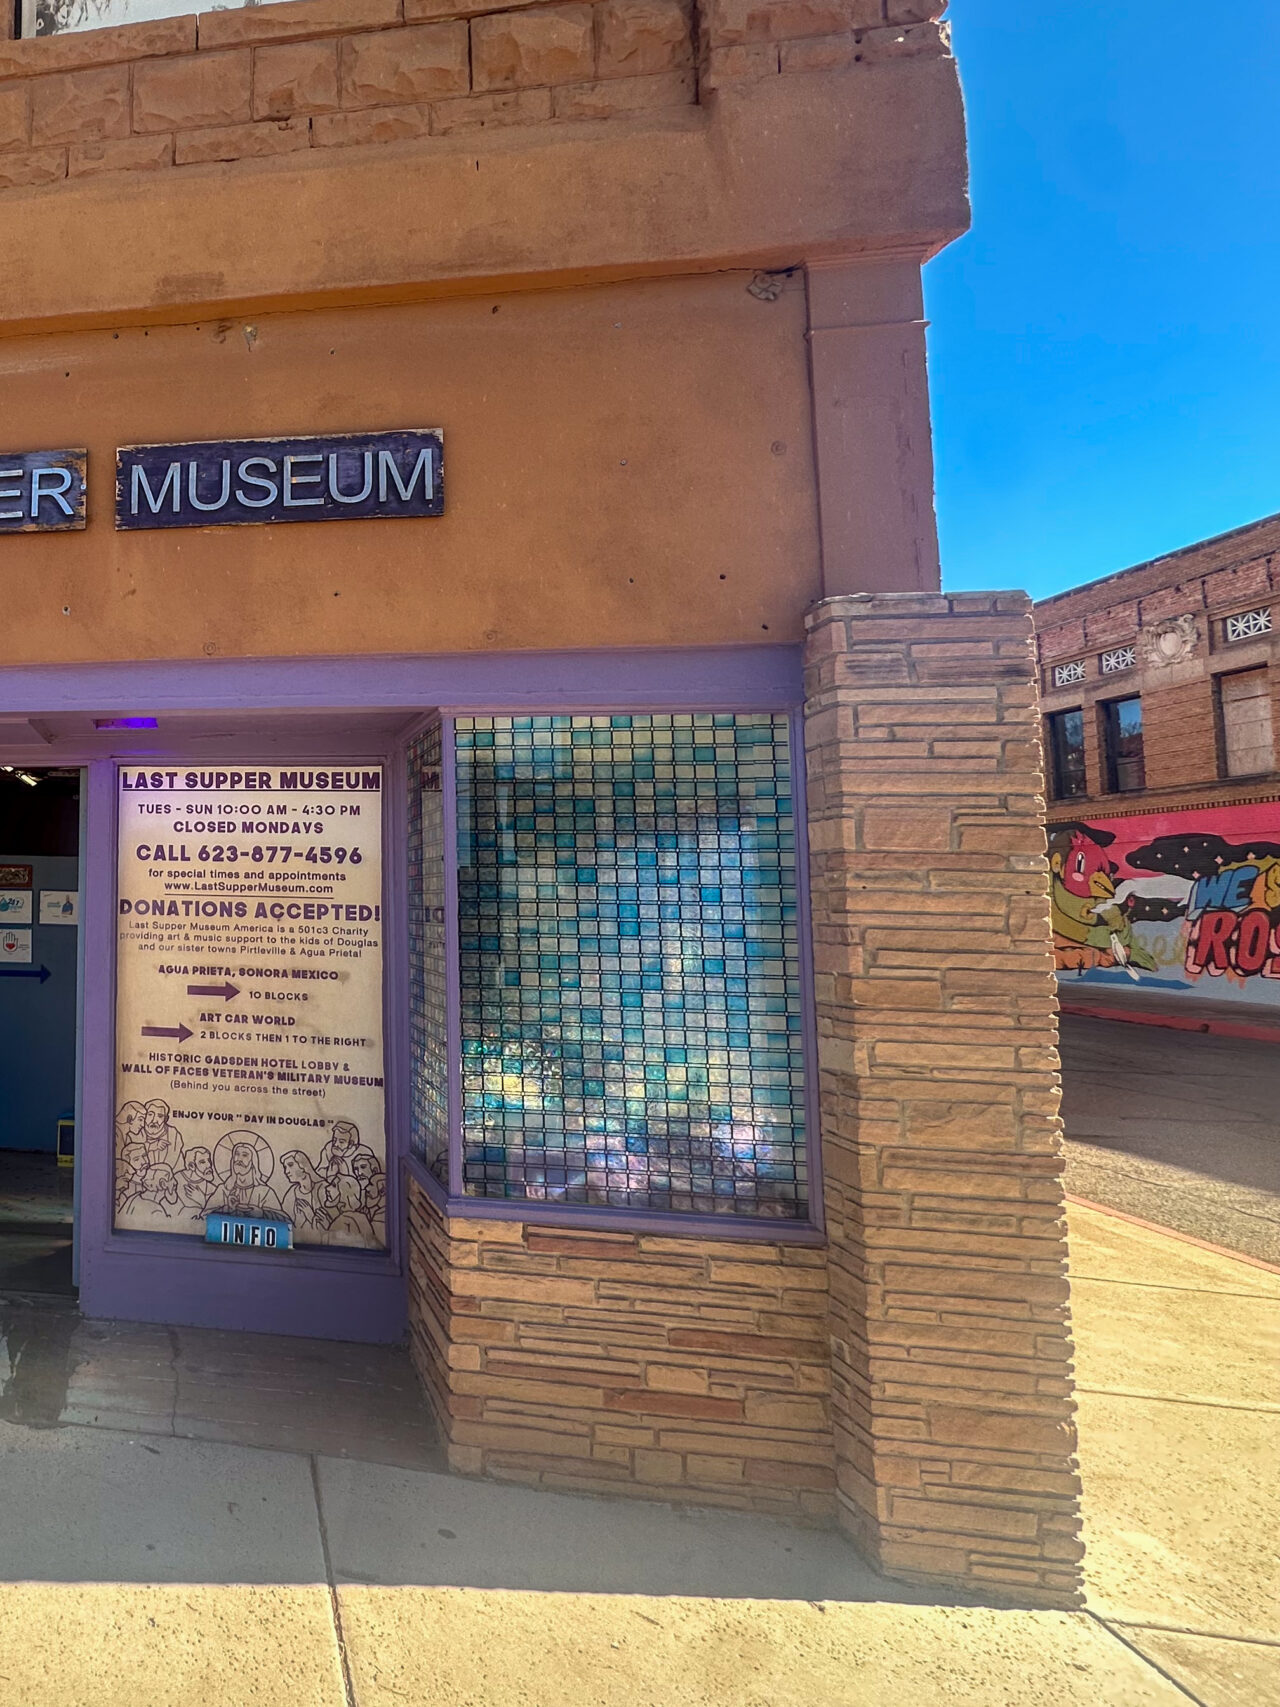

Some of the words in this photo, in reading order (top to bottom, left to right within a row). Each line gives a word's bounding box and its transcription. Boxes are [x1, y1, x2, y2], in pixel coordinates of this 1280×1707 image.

[129, 447, 435, 515] MUSEUM
[122, 771, 178, 789] LAST
[184, 771, 272, 789] SUPPER
[279, 771, 381, 790] MUSEUM
[137, 803, 172, 815] TUES
[185, 803, 213, 815] SUN
[217, 804, 262, 815] 10:00
[266, 804, 288, 815] AM
[302, 804, 336, 816] 4:30
[340, 804, 361, 816] PM
[173, 821, 237, 833] CLOSED
[241, 821, 324, 834] MONDAYS
[136, 844, 191, 861] CALL
[197, 844, 363, 864] 623-877-4596
[148, 868, 164, 878] for
[166, 868, 207, 880] special
[209, 869, 240, 879] times
[243, 869, 265, 880] and
[268, 870, 347, 882] appointments
[164, 881, 334, 894] www.LastSupperMuseum.com
[1194, 864, 1260, 910] WE
[119, 899, 248, 918] DONATIONS
[254, 901, 381, 922] ACCEPTED!
[129, 920, 149, 930] Last
[152, 921, 187, 932] Supper
[190, 922, 230, 932] Museum
[233, 923, 274, 933] America
[277, 924, 286, 933] is
[298, 925, 329, 935] 501c3
[331, 926, 370, 938] Charity
[120, 932, 164, 942] providing
[167, 932, 181, 941] art
[183, 933, 191, 942] &
[193, 933, 223, 943] music
[225, 934, 263, 945] support
[266, 935, 278, 944] to
[280, 935, 296, 945] the
[299, 937, 320, 946] kids
[323, 937, 334, 946] of
[337, 937, 379, 949] Douglas
[1192, 909, 1280, 974] RO
[138, 943, 156, 951] and
[177, 943, 205, 952] sister
[207, 945, 237, 954] towns
[240, 945, 287, 956] Pirtleville
[289, 946, 296, 956] &
[299, 947, 326, 958] Agua
[158, 964, 190, 975] AGUA
[192, 965, 237, 978] PRIETA,
[238, 967, 289, 979] SONORA
[291, 969, 339, 980] MEXICO
[249, 990, 262, 1000] 10
[264, 991, 309, 1002] BLOCKS
[199, 1012, 222, 1023] ART
[224, 1013, 249, 1025] CAR
[251, 1014, 296, 1026] WORLD
[200, 1030, 207, 1039] 2
[209, 1030, 252, 1041] BLOCKS
[255, 1032, 282, 1043] THEN
[285, 1034, 290, 1043] 1
[292, 1034, 308, 1044] TO
[310, 1035, 331, 1046] THE
[333, 1036, 367, 1047] RIGHT
[148, 1051, 202, 1063] HISTORIC
[204, 1055, 259, 1067] GADSDEN
[261, 1057, 299, 1069] HOTEL
[301, 1060, 340, 1071] LOBBY
[342, 1062, 351, 1072] &
[121, 1062, 152, 1074] WALL
[154, 1064, 171, 1075] OF
[172, 1065, 209, 1077] FACES
[211, 1067, 275, 1081] VETERAN'S
[277, 1070, 331, 1084] MILITARY
[333, 1074, 384, 1088] MUSEUM
[170, 1079, 209, 1091] (Behind
[212, 1082, 231, 1093] you
[233, 1083, 269, 1094] across
[271, 1085, 289, 1095] the
[291, 1086, 327, 1099] street)
[172, 1109, 205, 1120] ENJOY
[207, 1111, 234, 1122] YOUR
[244, 1114, 265, 1124] DAY
[266, 1115, 276, 1125] IN
[277, 1117, 326, 1128] DOUGLAS
[222, 1222, 276, 1247] INFO
